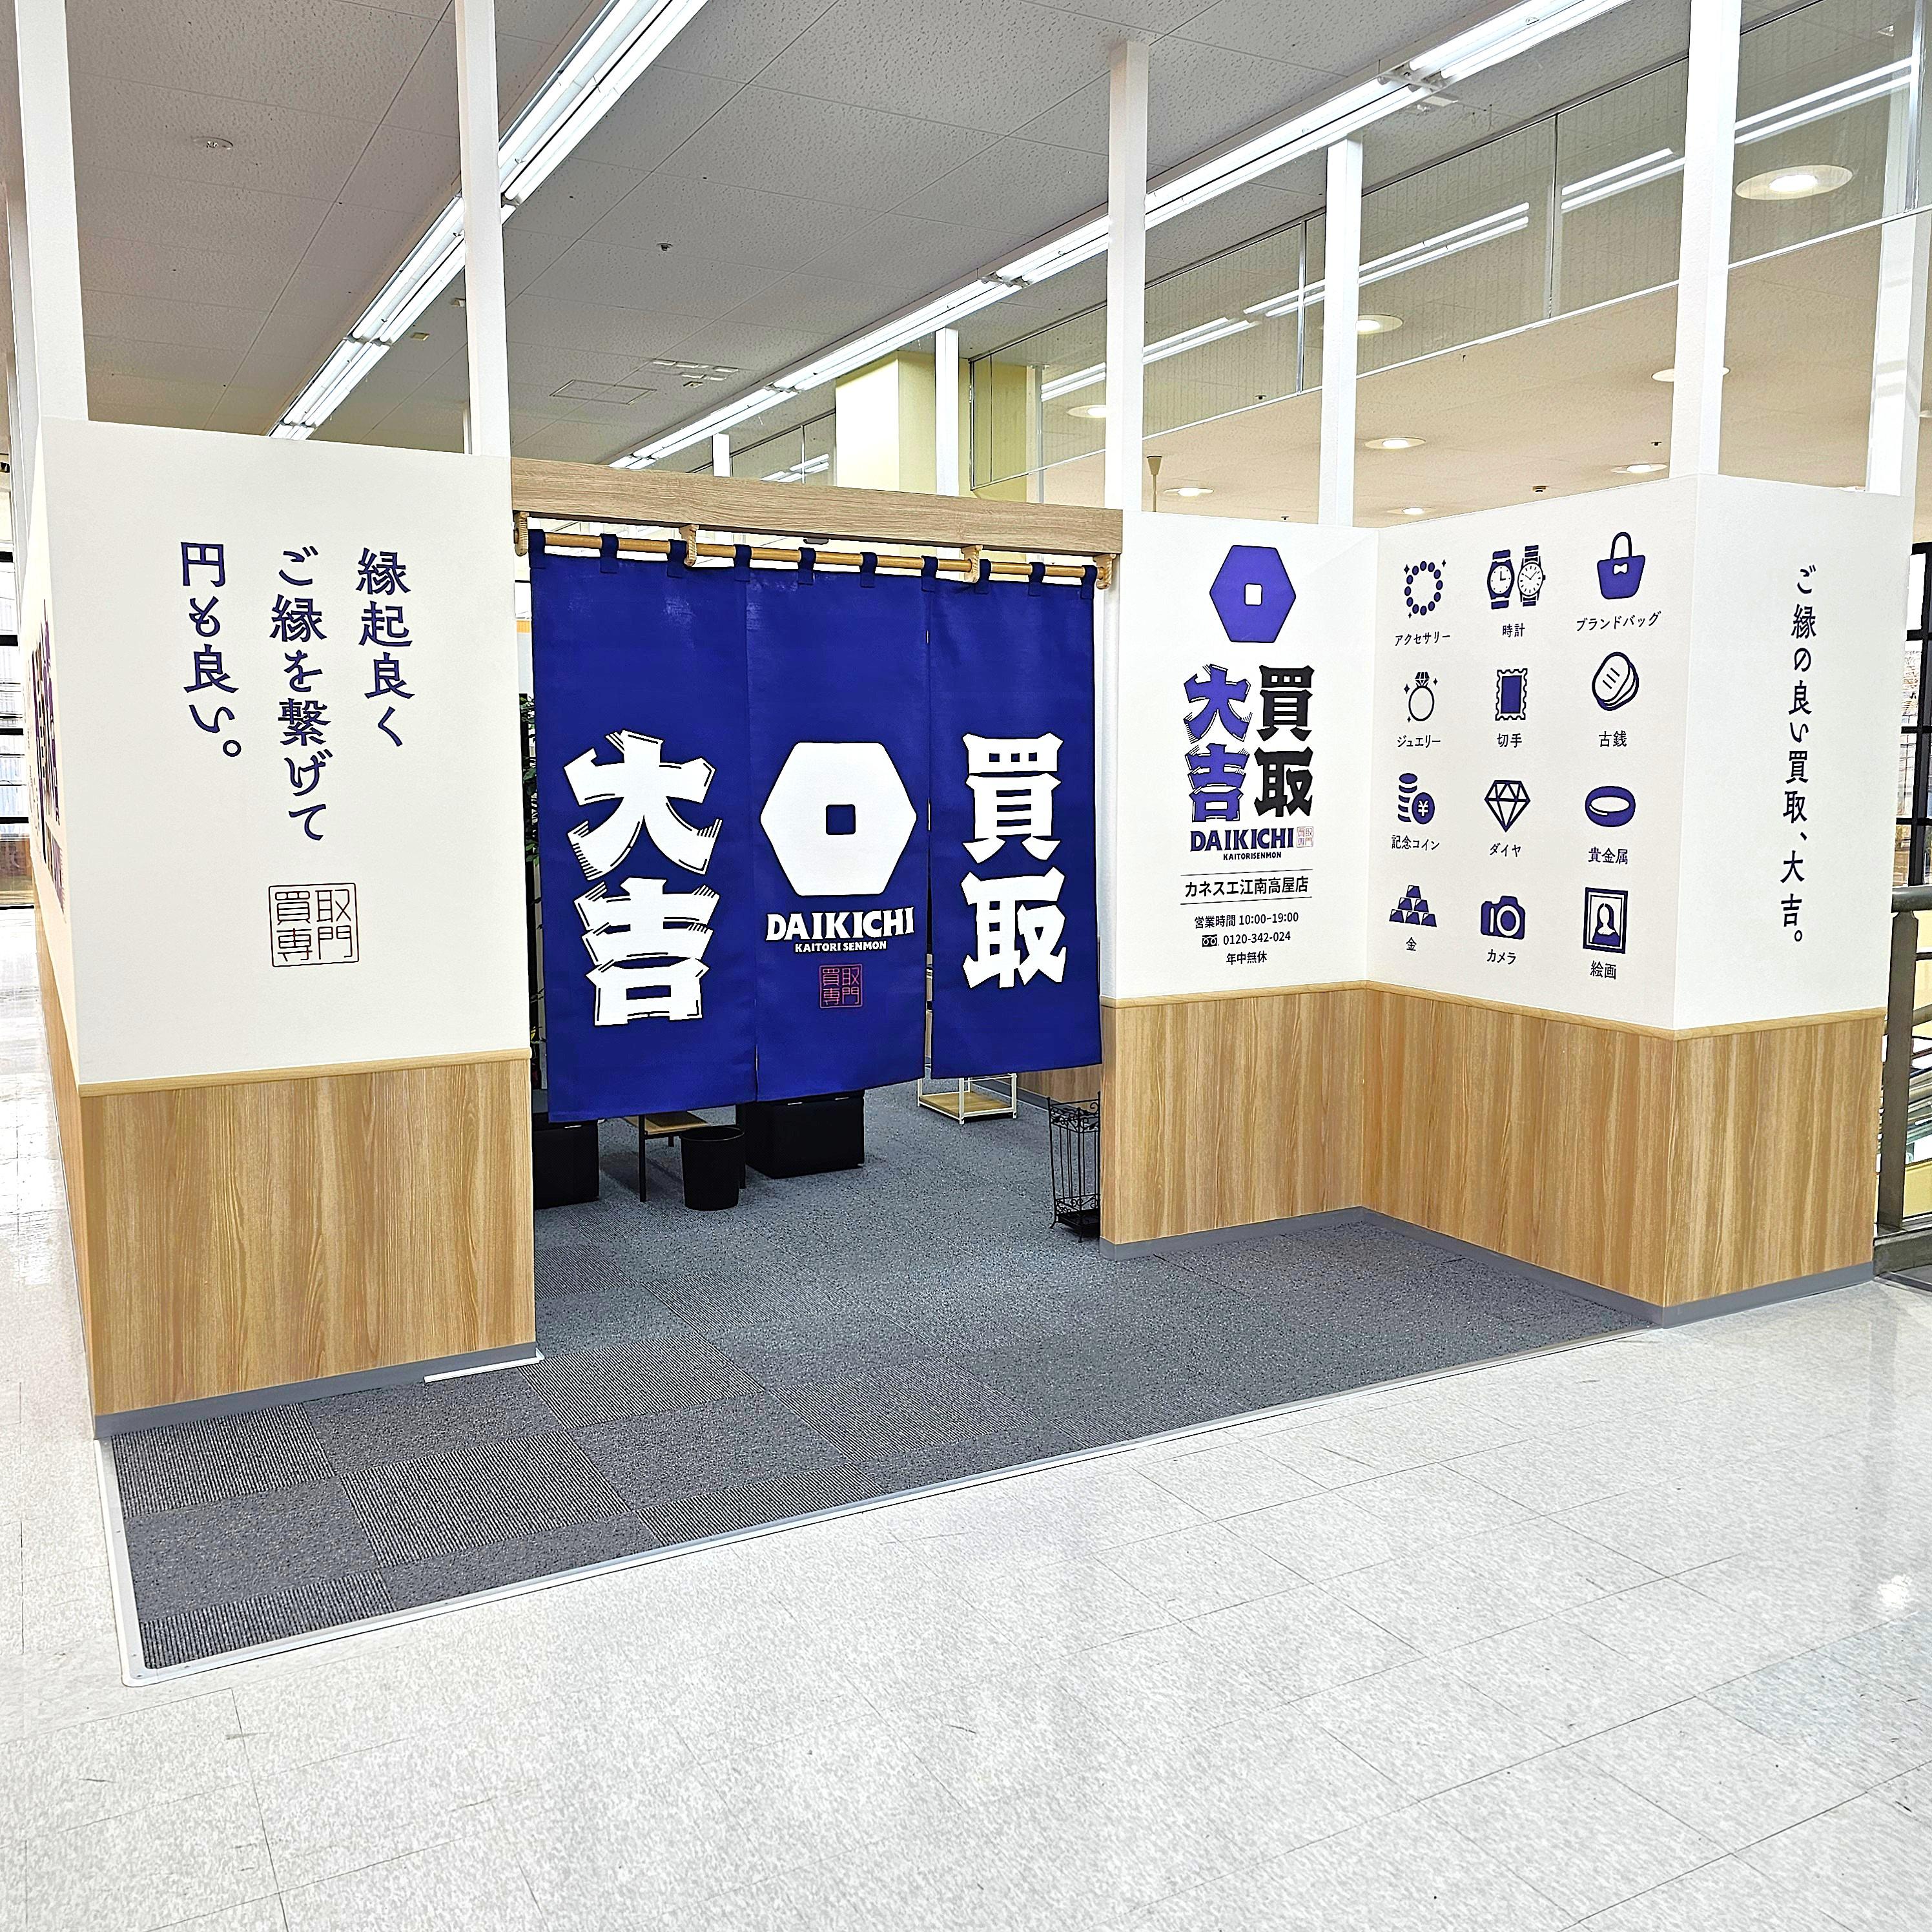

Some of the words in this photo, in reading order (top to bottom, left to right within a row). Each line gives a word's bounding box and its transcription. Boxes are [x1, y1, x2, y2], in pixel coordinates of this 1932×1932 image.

[1502, 622, 1526, 638] 時計
[1576, 610, 1661, 632] ブランドバッグ
[355, 546, 415, 748] 縁起良く
[1394, 631, 1451, 646] アクセサリー
[180, 540, 242, 758] 円も良い。
[269, 546, 333, 842] ご縁を繋げて
[1183, 663, 1253, 823] 大吉
[1254, 664, 1316, 818] 買取
[1396, 734, 1441, 748] ジュエリー
[1496, 733, 1523, 748] 切手
[1598, 730, 1628, 748] 古銭
[1780, 564, 1818, 943] ご縁の良い買取、大吉。
[1190, 828, 1294, 852] DAIKICHI
[1391, 834, 1441, 851] 記念コイン
[1489, 842, 1522, 858] ダイヤ
[1588, 846, 1629, 865] 貴金属
[961, 732, 1067, 989] 買取
[563, 729, 723, 1027] 大吉
[1185, 876, 1309, 898] カネスエ江南高屋店
[766, 907, 914, 941] DAIKICHI
[1194, 914, 1236, 929] 営業時間
[1238, 912, 1299, 925] 10:00-19:00
[795, 943, 841, 952] KAITORI
[843, 940, 887, 951] SENMON
[1223, 930, 1291, 945] 0120-342-024
[1405, 936, 1417, 952] 金
[1226, 950, 1268, 965] 年中無休
[1486, 949, 1517, 965] カメラ
[1590, 960, 1618, 980] 絵画
